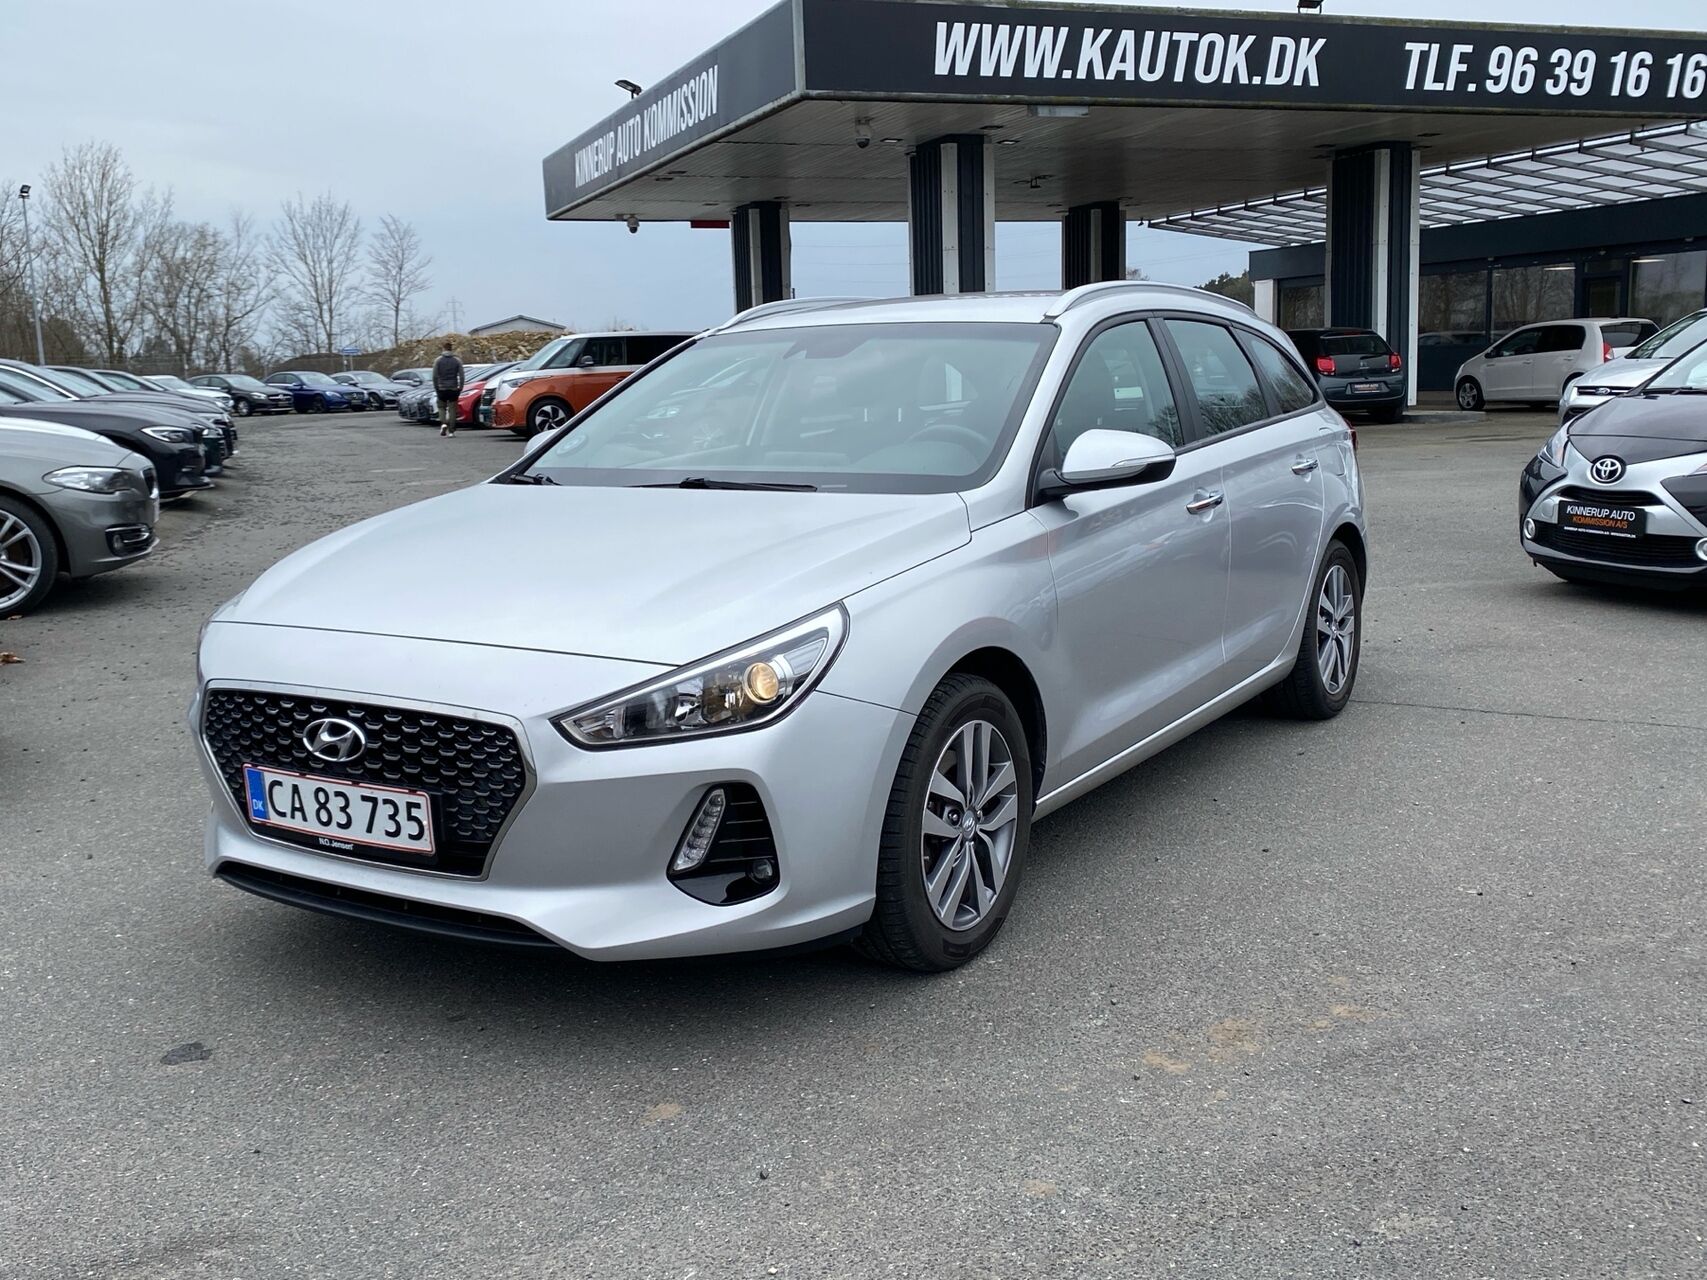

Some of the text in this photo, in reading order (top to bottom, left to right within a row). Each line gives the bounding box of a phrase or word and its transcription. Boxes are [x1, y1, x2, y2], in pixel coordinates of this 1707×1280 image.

[934, 21, 1327, 87] WWW.KAUTOK.DK
[1405, 42, 1707, 99] TLF. 96 39 16 16
[575, 65, 718, 188] KINNERUP AUTO KOMMISSION
[1566, 505, 1636, 521] KINNERUP AUTO
[1573, 515, 1615, 527] KOMMISSION
[252, 798, 265, 812] DK
[267, 780, 425, 841] CA 83 735
